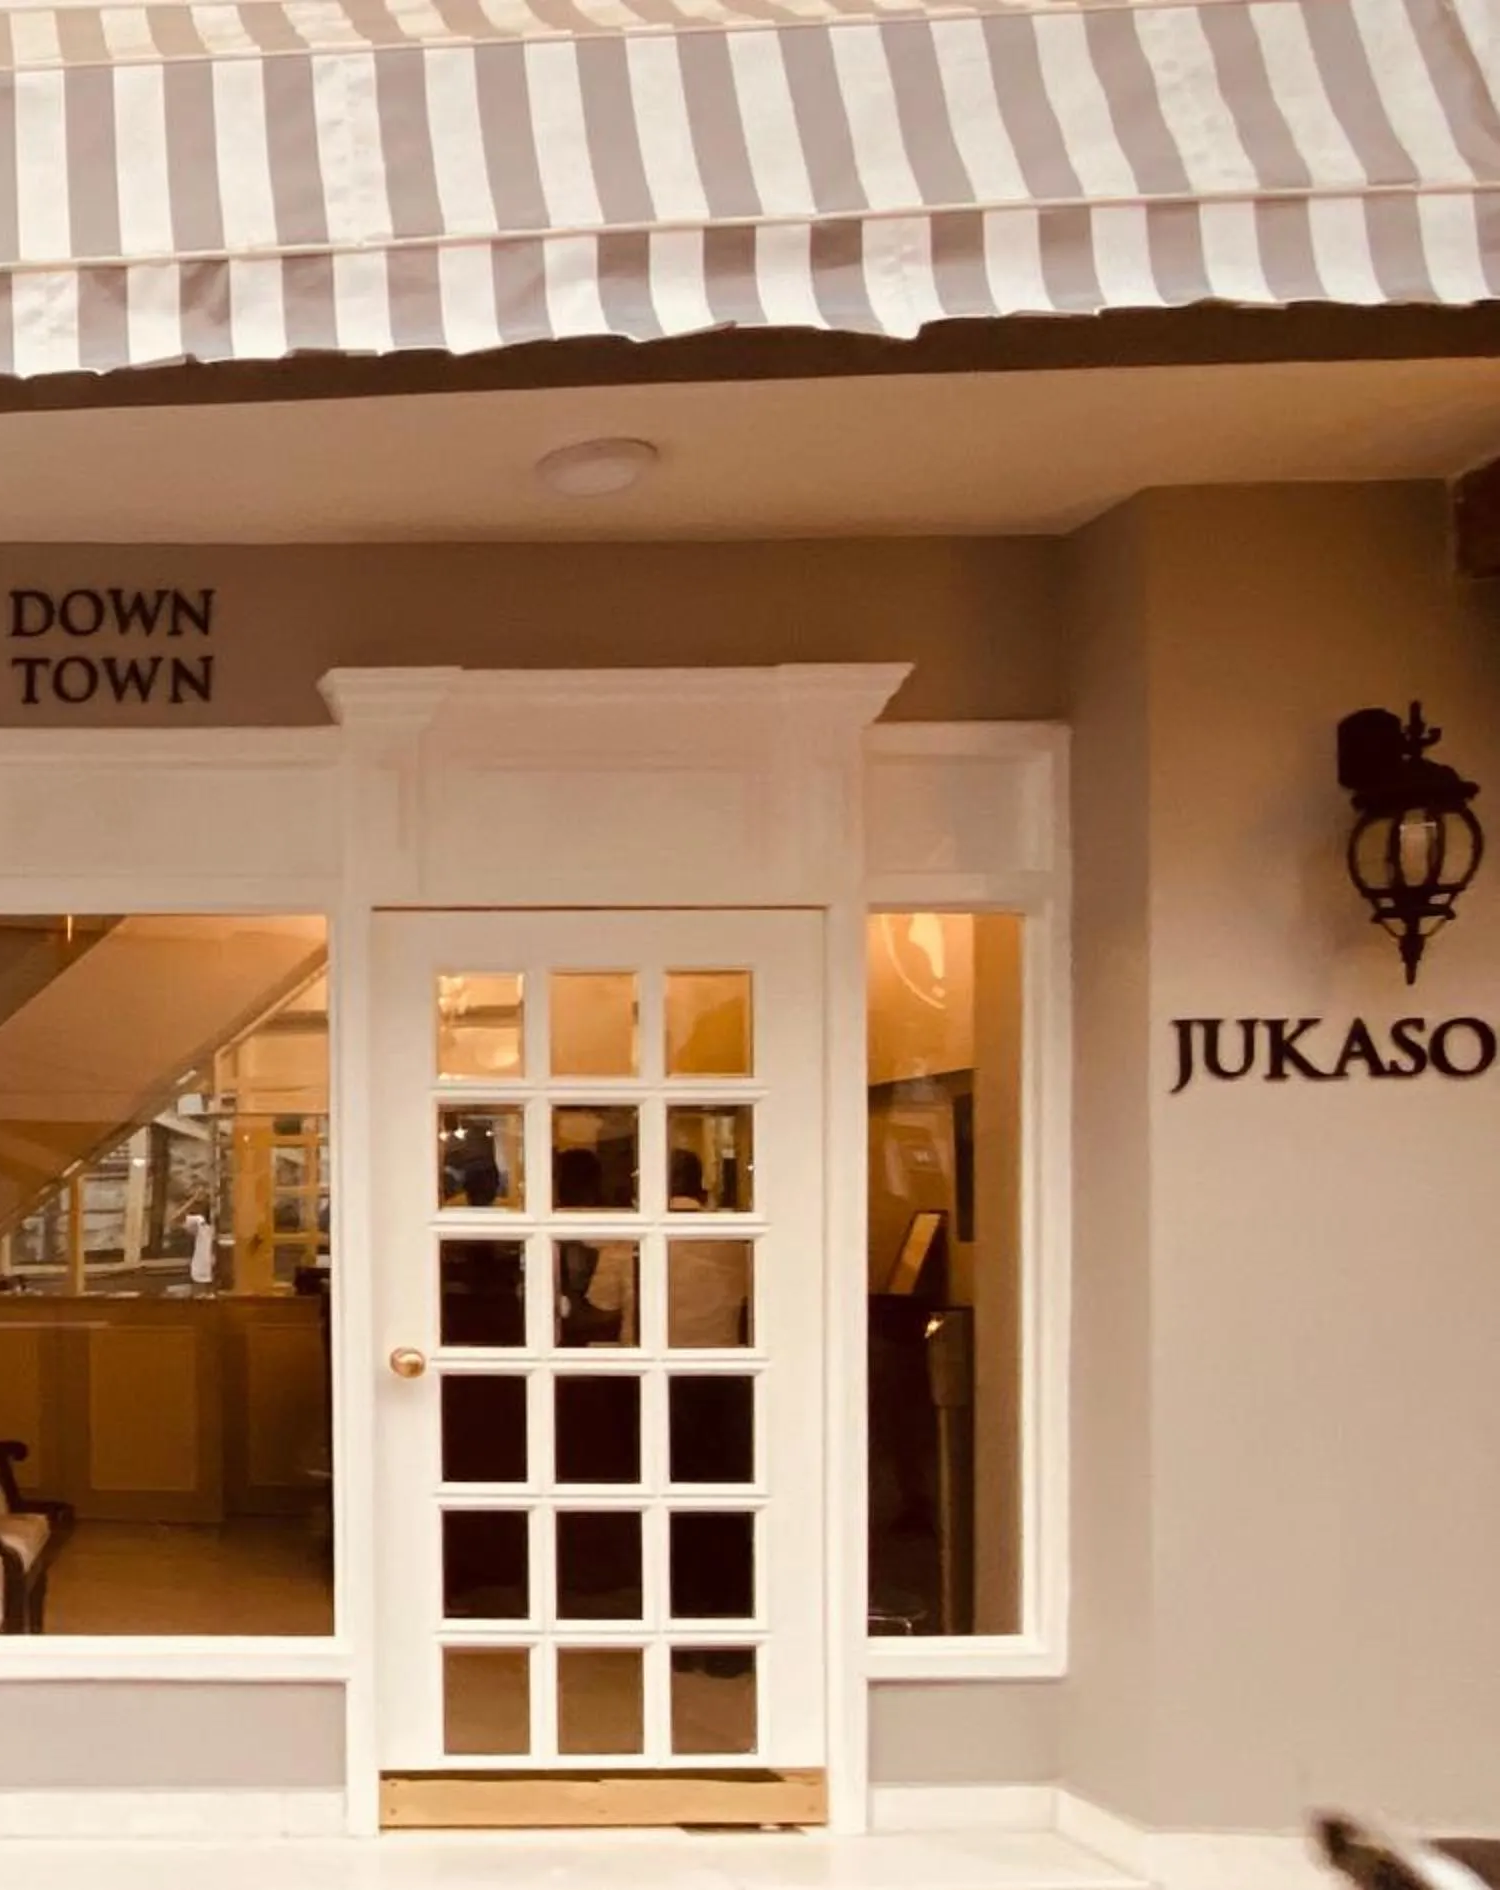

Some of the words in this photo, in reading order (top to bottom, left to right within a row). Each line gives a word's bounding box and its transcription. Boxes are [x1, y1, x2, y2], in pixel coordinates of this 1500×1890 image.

[8, 587, 216, 638] DOWN
[10, 655, 215, 705] TOWN
[1170, 1017, 1497, 1095] JUKASO
